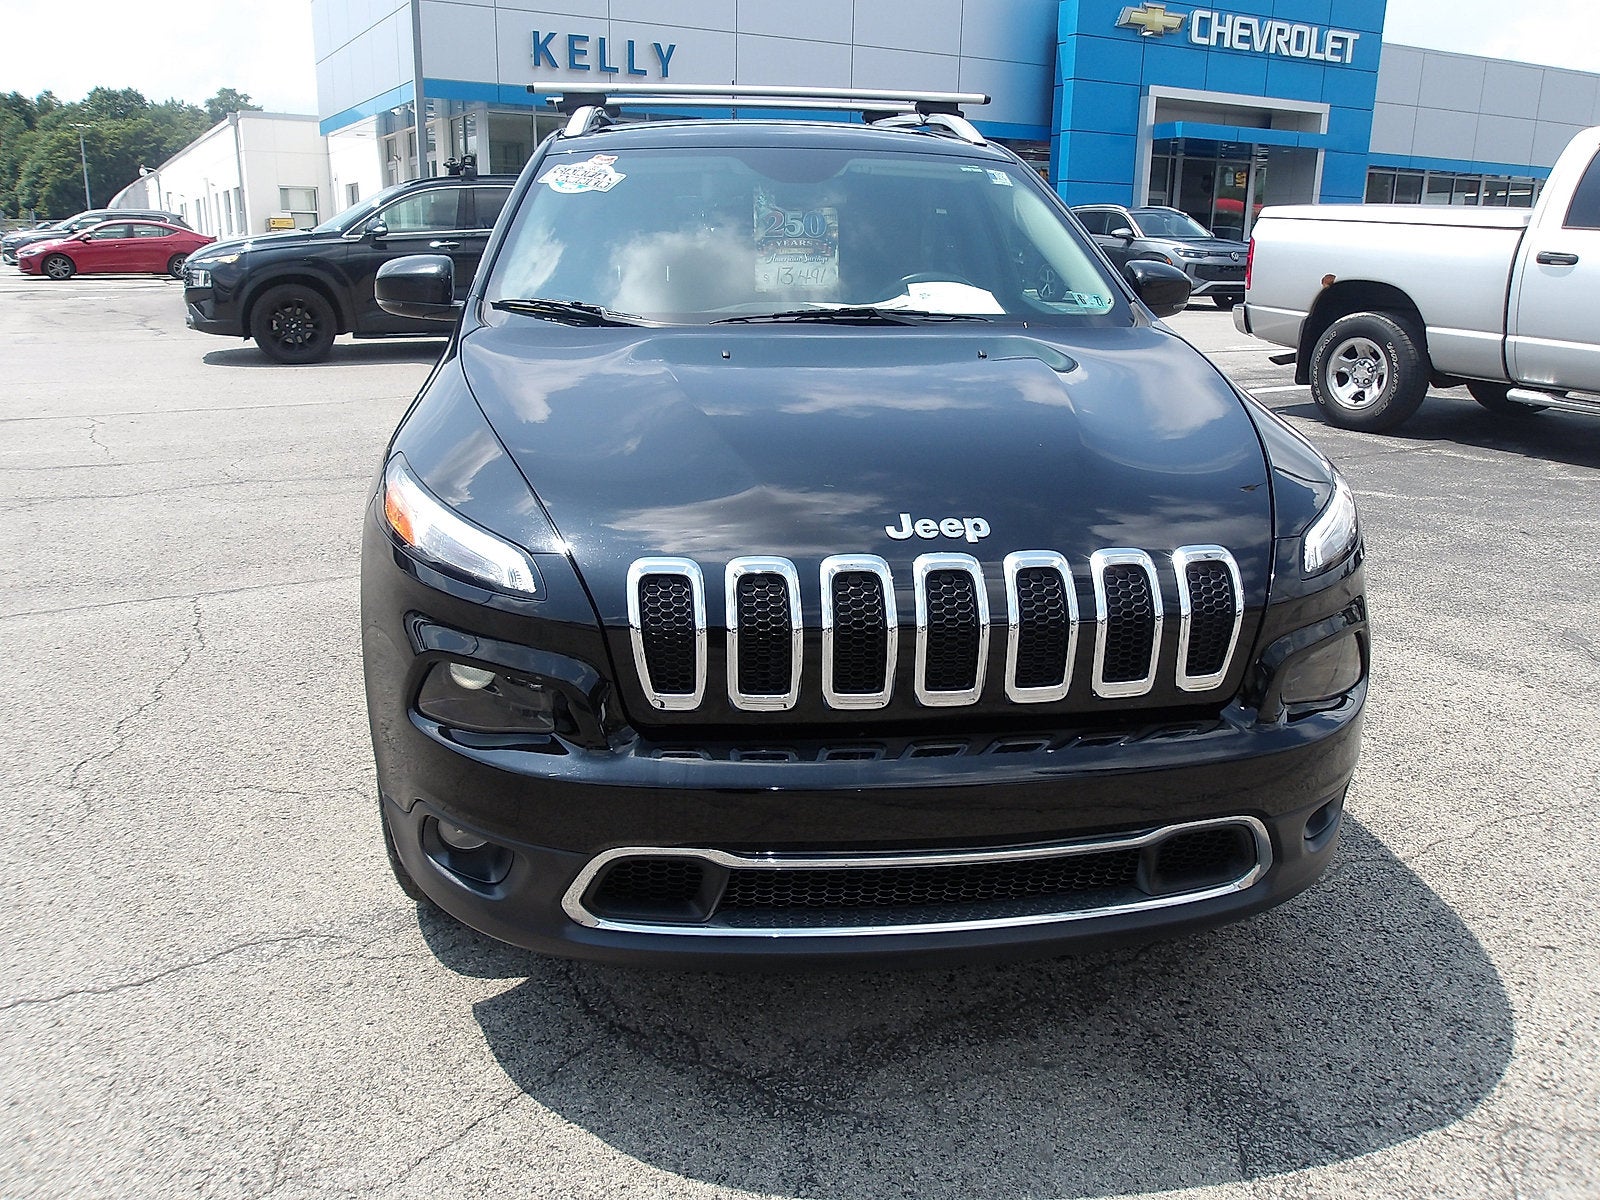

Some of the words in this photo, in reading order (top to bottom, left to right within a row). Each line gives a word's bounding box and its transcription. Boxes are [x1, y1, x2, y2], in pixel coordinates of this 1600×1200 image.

[532, 30, 677, 78] KELLY
[1190, 9, 1360, 64] CHEVROLET
[764, 210, 827, 238] 250
[884, 512, 992, 544] Jeep
